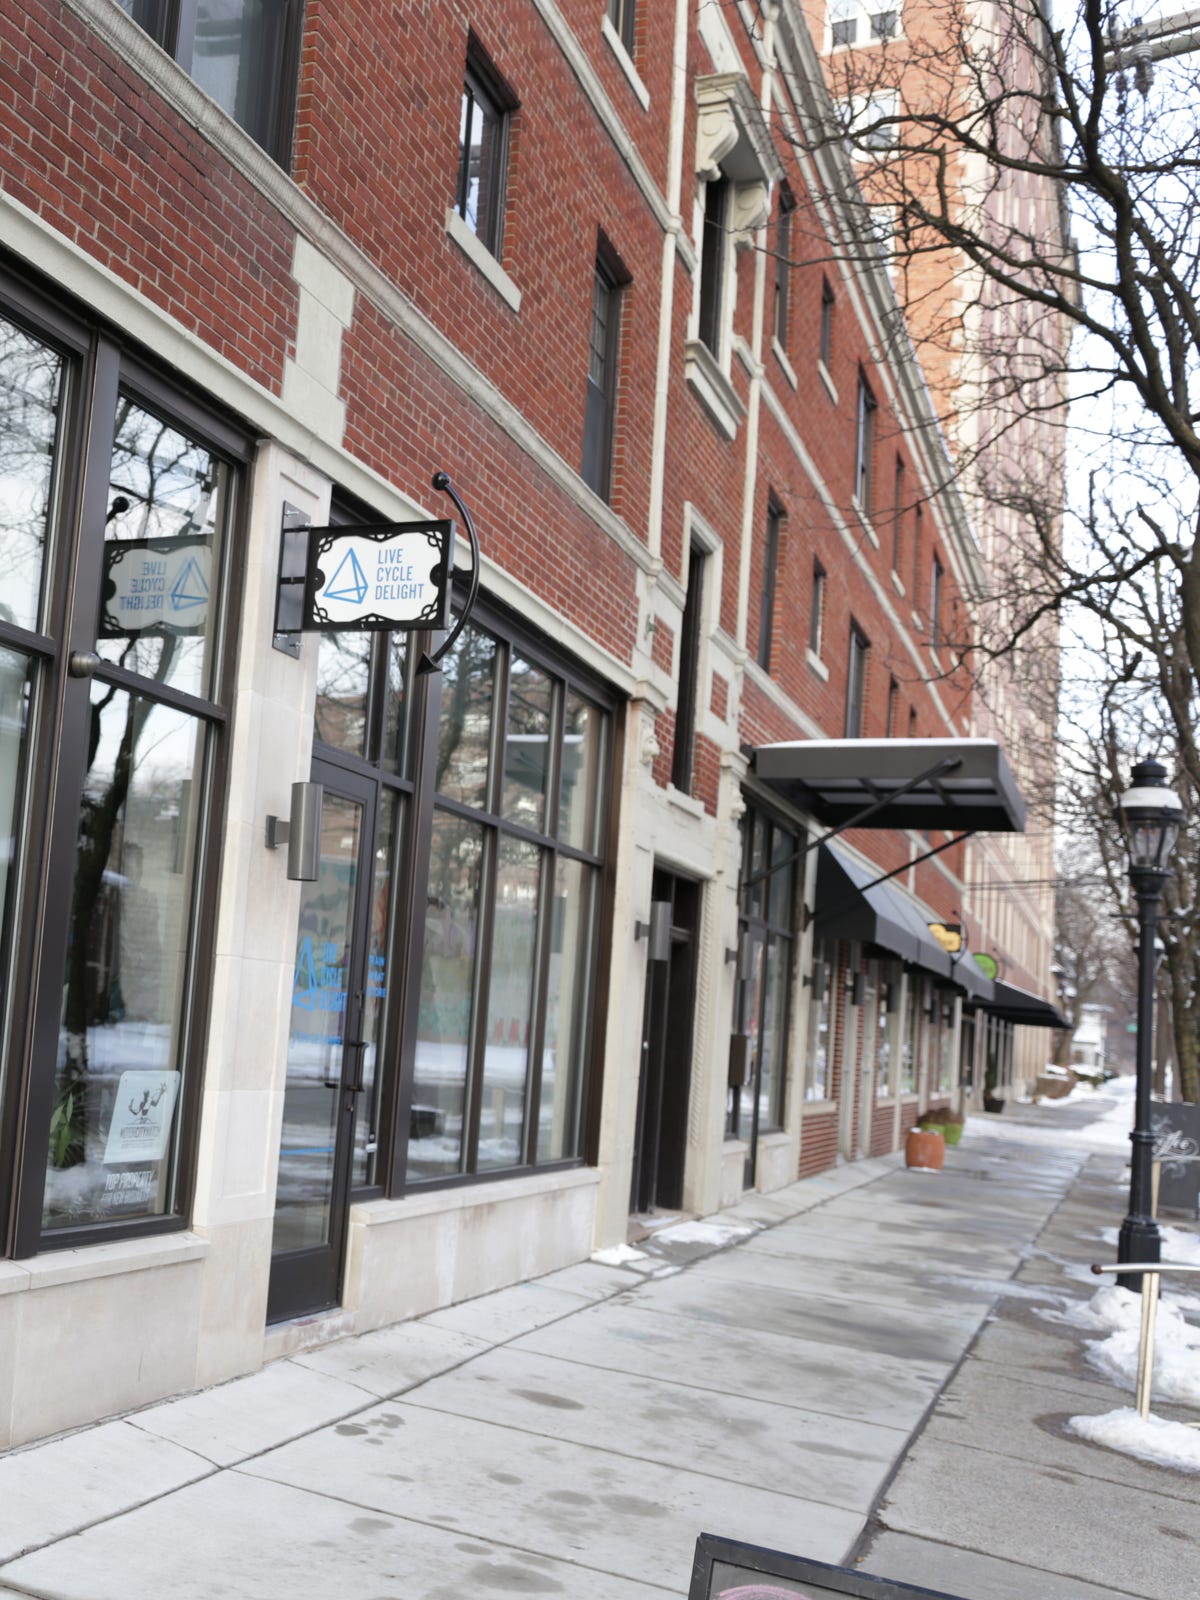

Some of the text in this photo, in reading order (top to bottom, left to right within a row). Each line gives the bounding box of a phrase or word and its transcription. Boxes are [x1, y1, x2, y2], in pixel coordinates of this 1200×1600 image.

[377, 548, 404, 565] LIVE
[376, 566, 414, 583] CYCLE
[375, 584, 425, 601] DELIGHT
